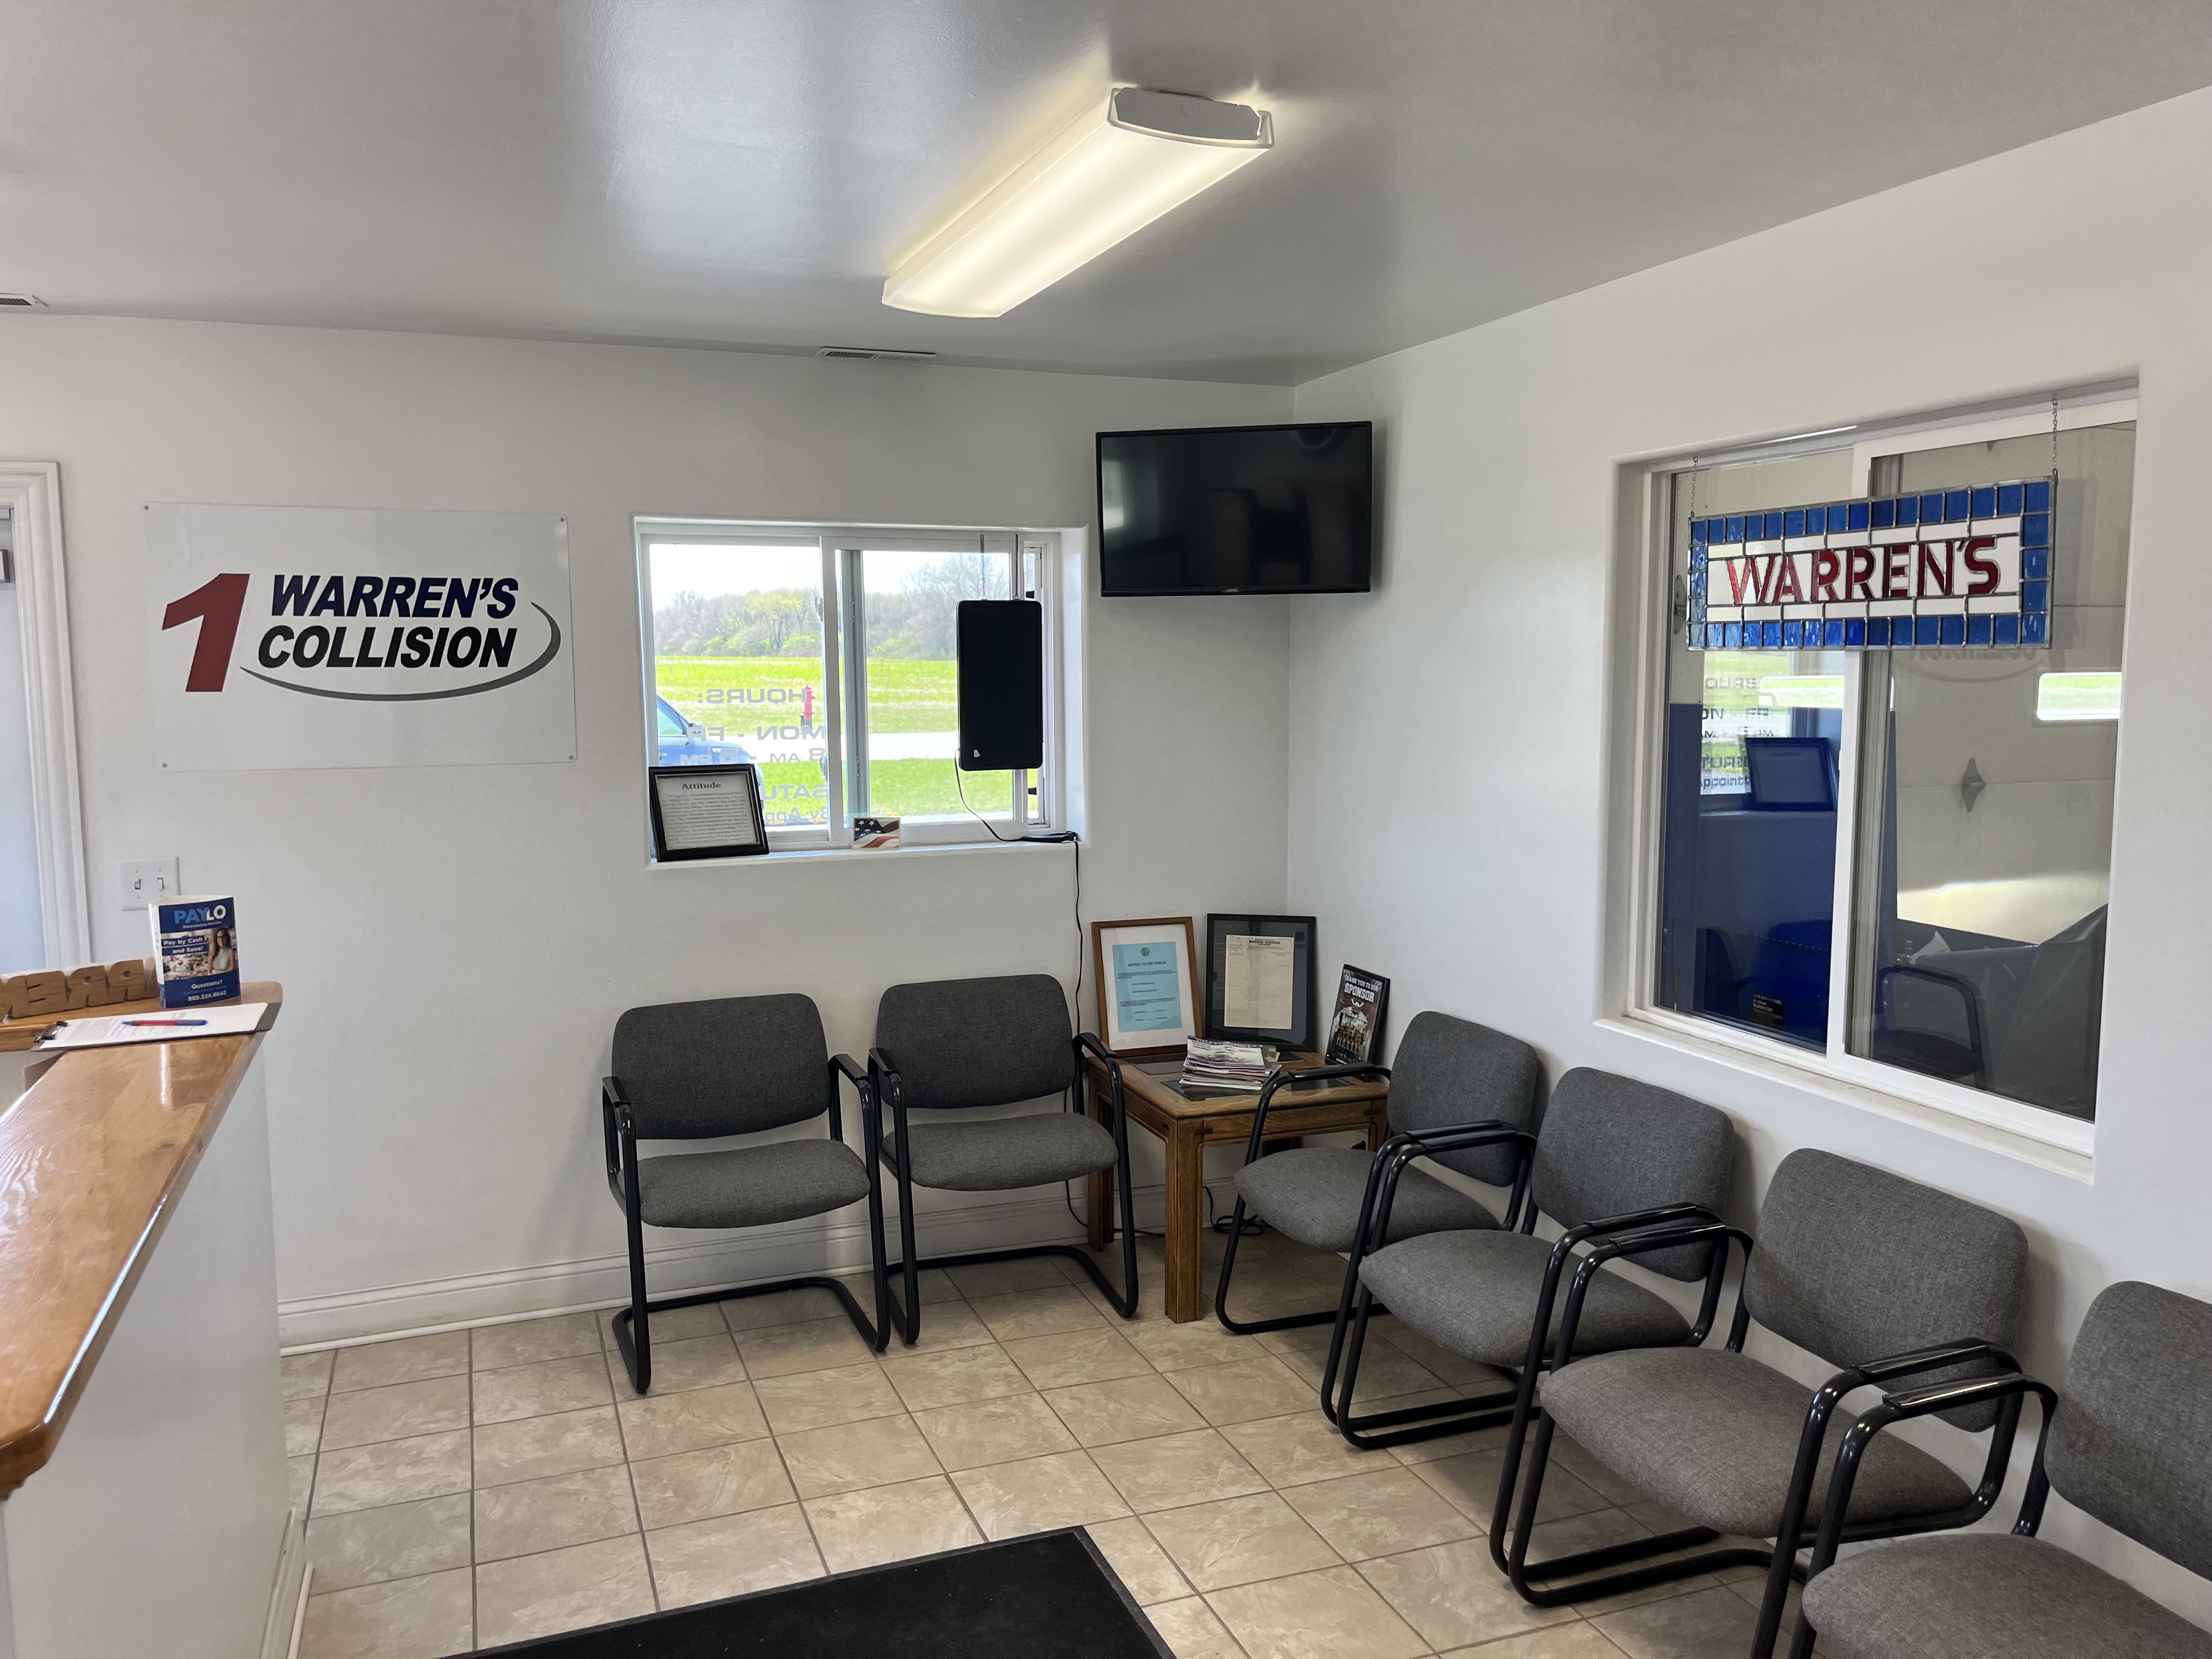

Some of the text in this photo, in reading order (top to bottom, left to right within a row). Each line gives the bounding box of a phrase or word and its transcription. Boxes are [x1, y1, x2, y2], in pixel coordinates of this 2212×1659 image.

[1725, 536, 2001, 605] WARREN'S
[271, 574, 519, 618] WARREN'S
[161, 573, 251, 693] 1
[258, 624, 518, 669] COLLISION
[681, 782, 721, 790] Attitude
[174, 905, 227, 924] PAYLO
[191, 979, 223, 989] Questions?
[1345, 974, 1358, 984] THANK
[1344, 983, 1374, 1003] SPONSOR
